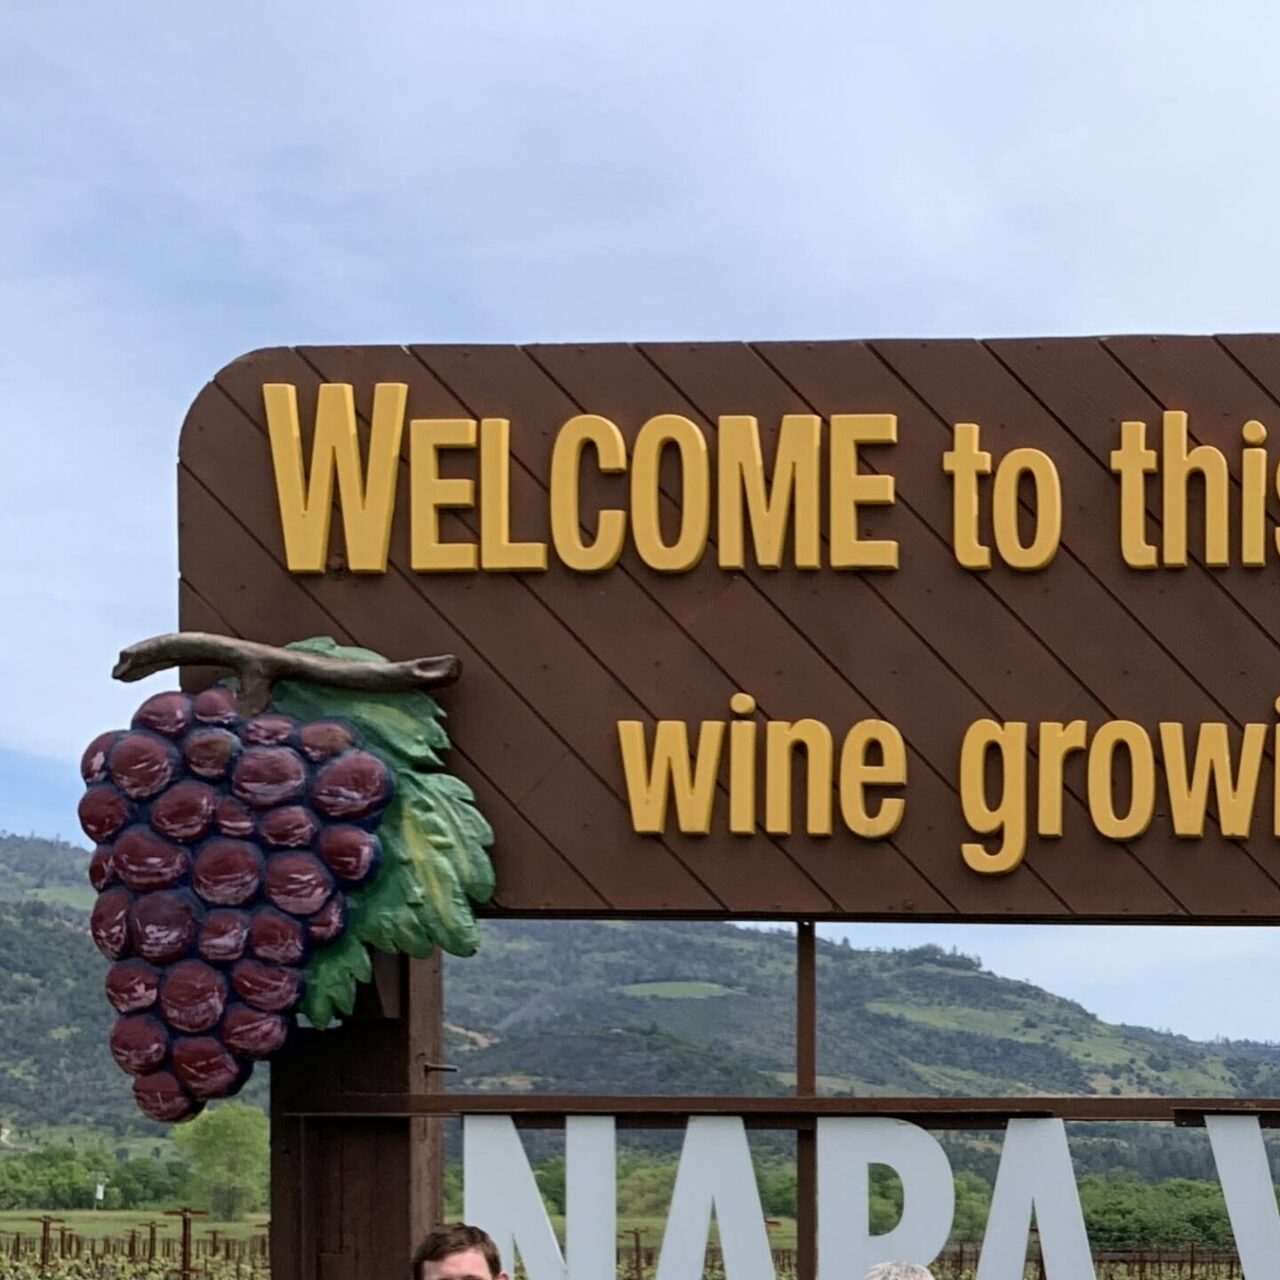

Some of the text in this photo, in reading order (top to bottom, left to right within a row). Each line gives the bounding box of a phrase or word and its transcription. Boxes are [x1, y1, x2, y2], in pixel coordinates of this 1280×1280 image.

[263, 383, 898, 574] WELCOME
[943, 422, 1062, 571] to
[617, 693, 907, 840] wine
